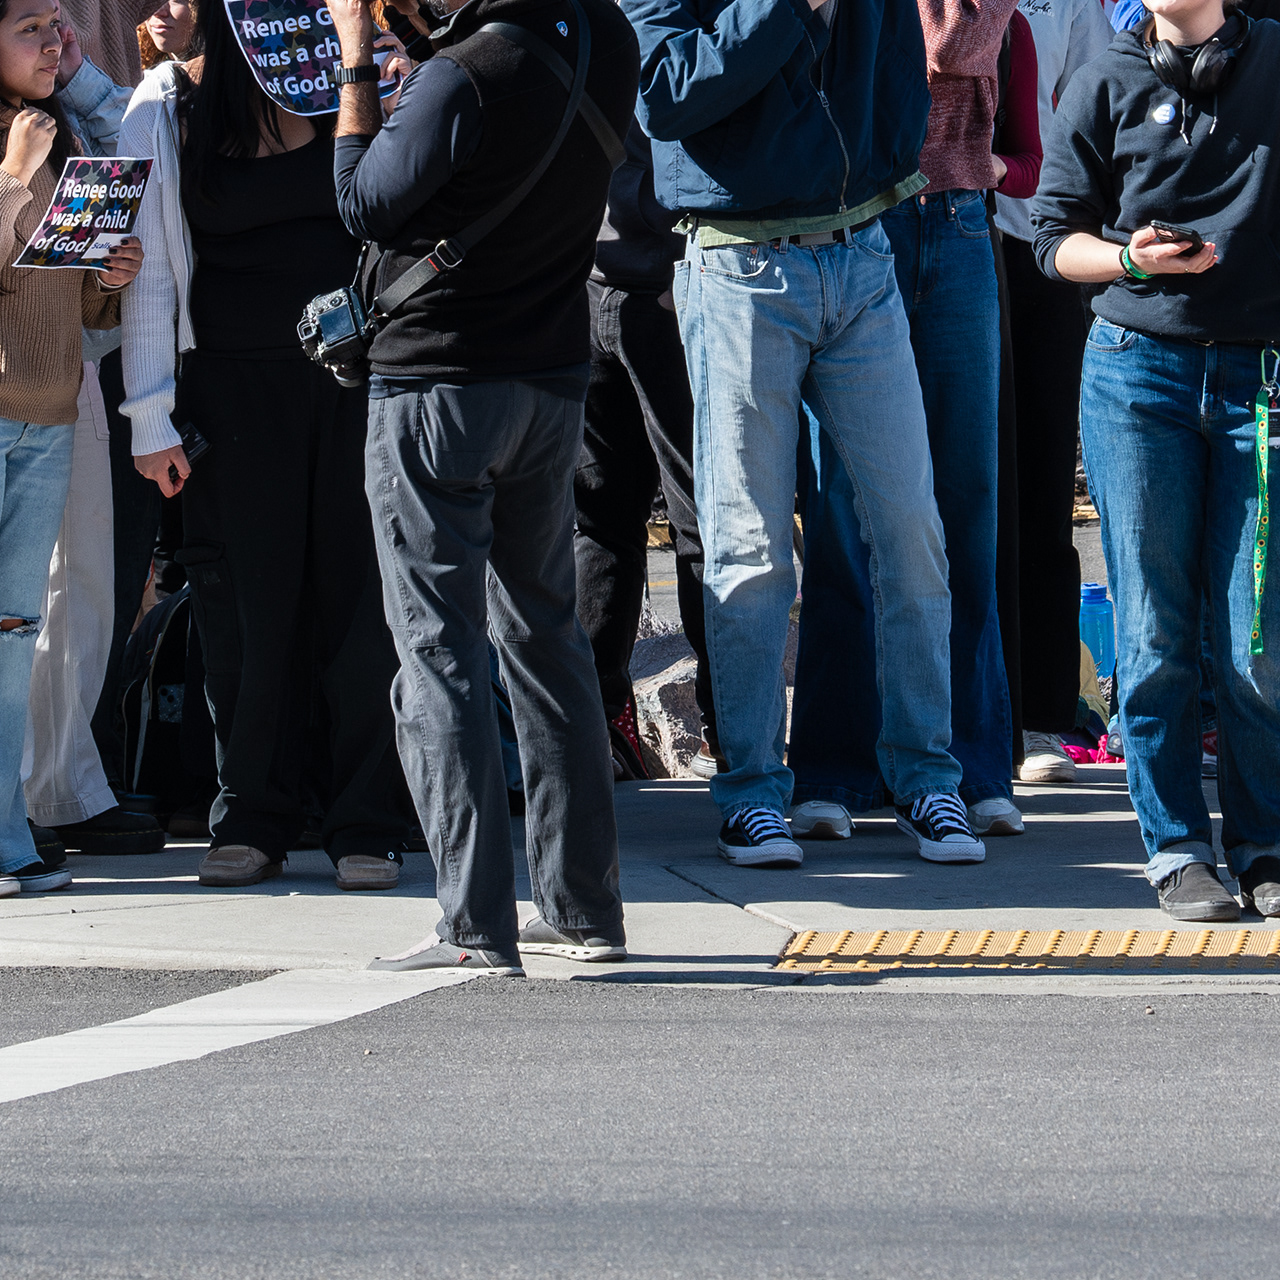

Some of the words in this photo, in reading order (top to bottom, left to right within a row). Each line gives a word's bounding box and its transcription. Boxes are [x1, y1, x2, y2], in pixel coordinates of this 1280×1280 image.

[241, 13, 312, 40] Renee
[252, 50, 292, 69] was
[296, 51, 310, 63] a
[265, 77, 283, 95] of
[284, 70, 336, 96] God.
[62, 179, 107, 199] Renee
[109, 178, 145, 199] Good
[50, 211, 81, 227] was
[81, 214, 94, 228] a
[94, 209, 131, 229] child
[34, 233, 59, 251] of
